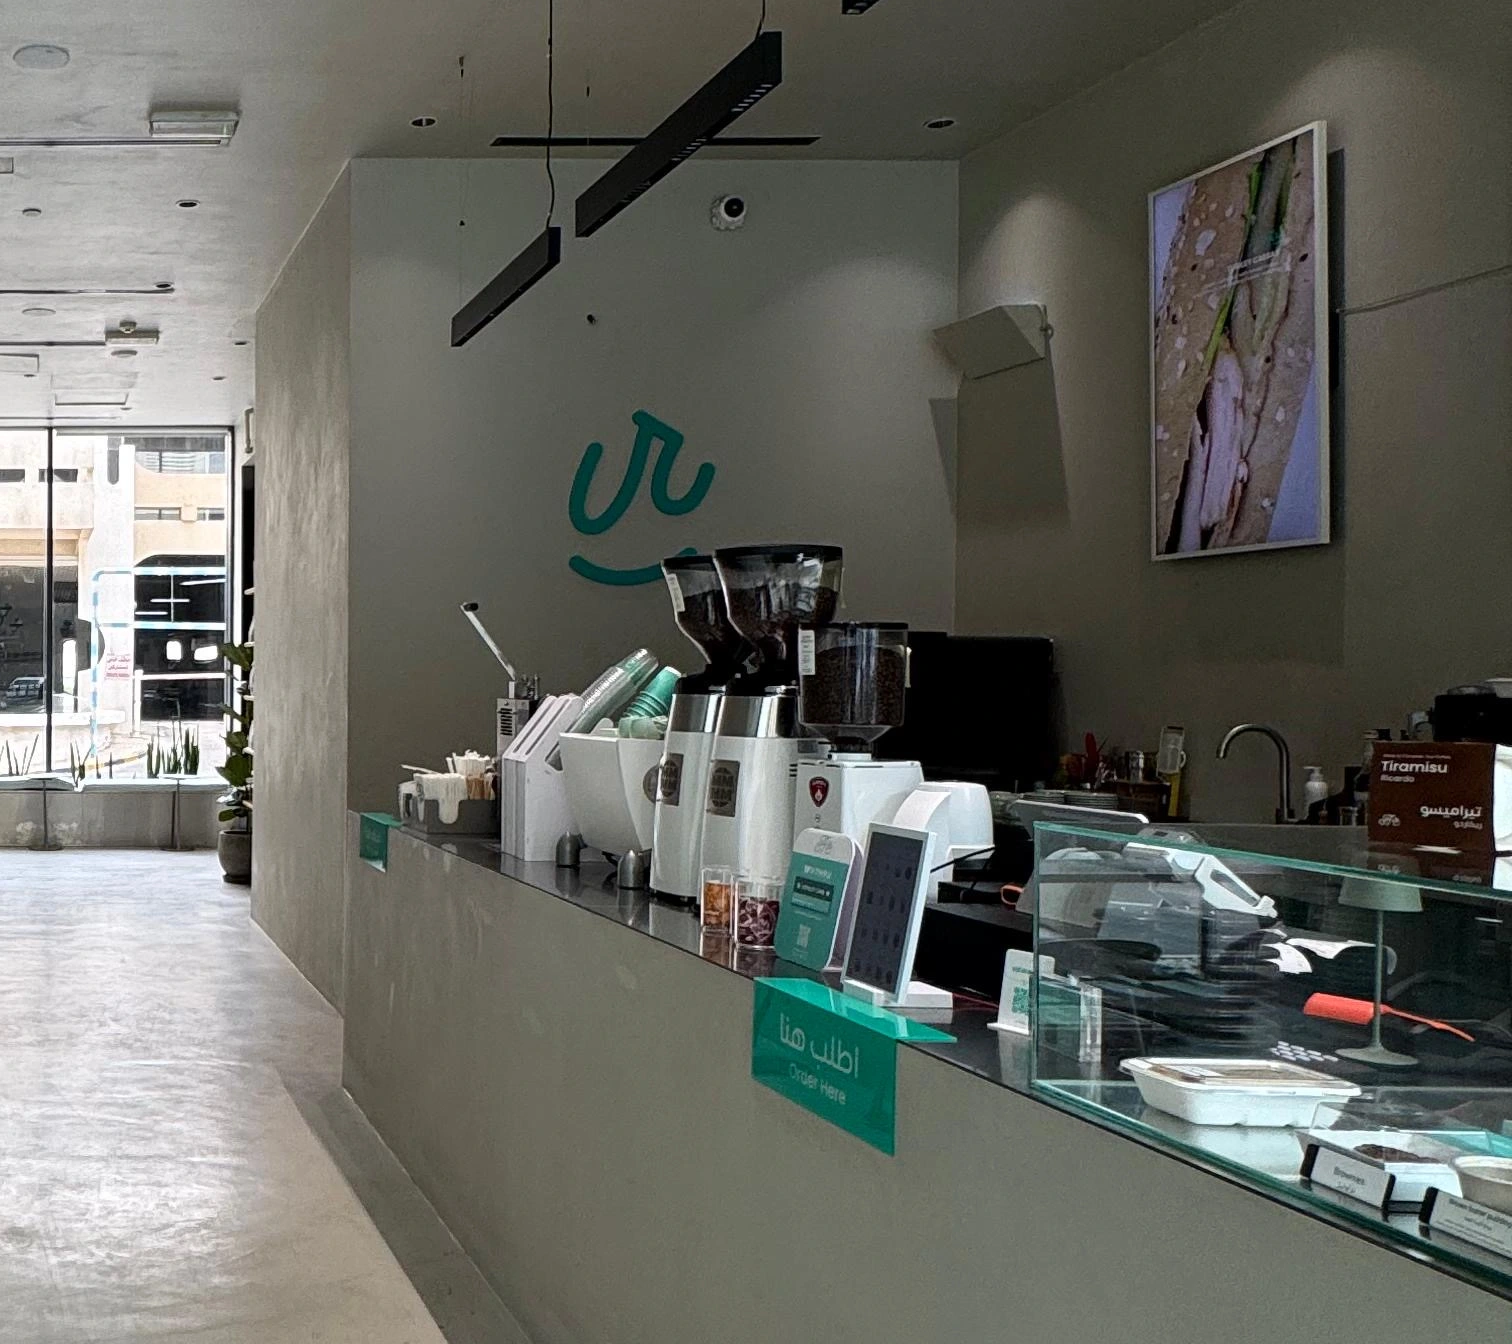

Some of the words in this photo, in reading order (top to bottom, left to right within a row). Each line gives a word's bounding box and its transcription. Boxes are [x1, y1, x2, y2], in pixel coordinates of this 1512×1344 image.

[1380, 760, 1448, 773] Tiramisu
[1420, 805, 1483, 820] تيراميسو
[779, 1012, 806, 1052] هنا
[809, 1035, 860, 1079] اطلب
[789, 1063, 819, 1090] Order
[819, 1079, 847, 1105] Here
